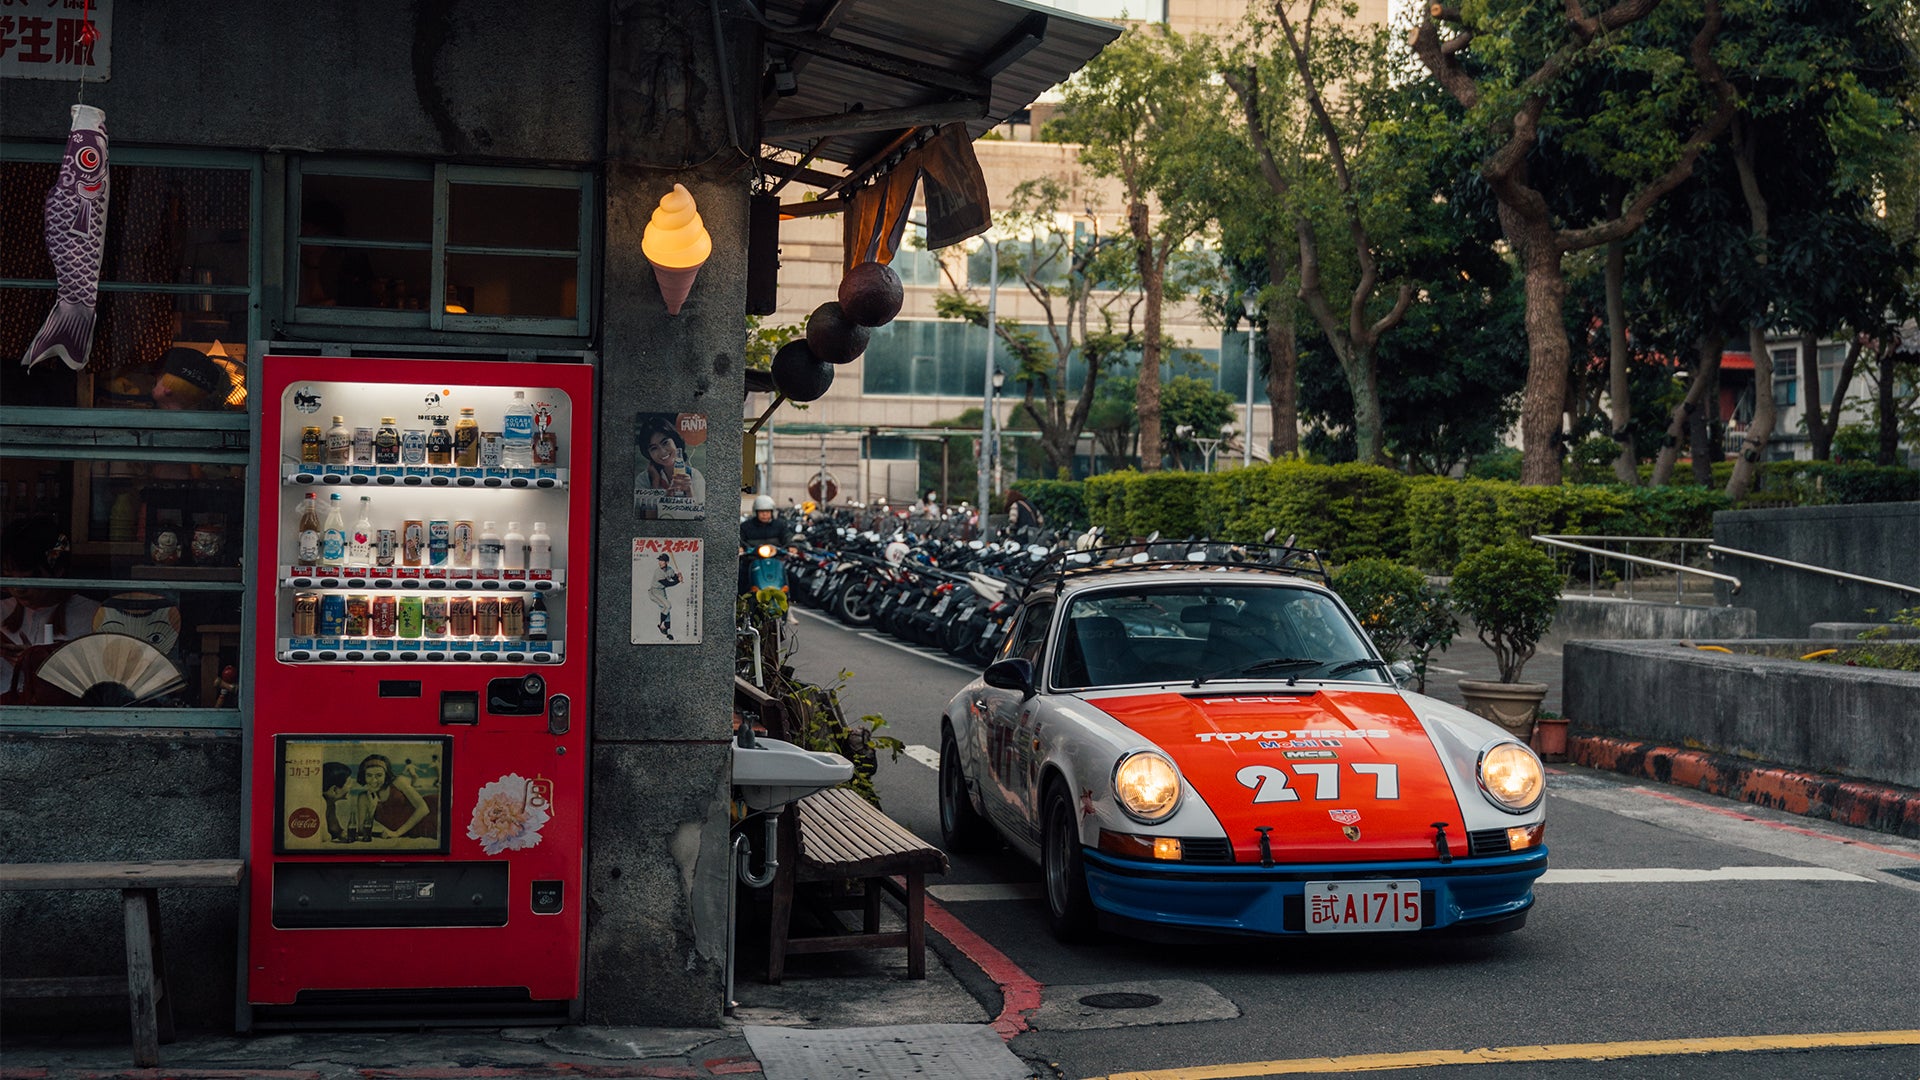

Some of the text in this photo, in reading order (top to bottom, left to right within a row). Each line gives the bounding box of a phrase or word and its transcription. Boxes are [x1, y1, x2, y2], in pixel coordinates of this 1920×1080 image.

[680, 419, 707, 431] FANTA
[645, 539, 699, 553] ベースボール
[1195, 729, 1390, 742] TOYO TIRES
[1259, 740, 1319, 749] Mobil
[1235, 763, 1400, 804] 277
[291, 818, 317, 829] Coca-Cola
[1311, 892, 1419, 924] 試A1715
